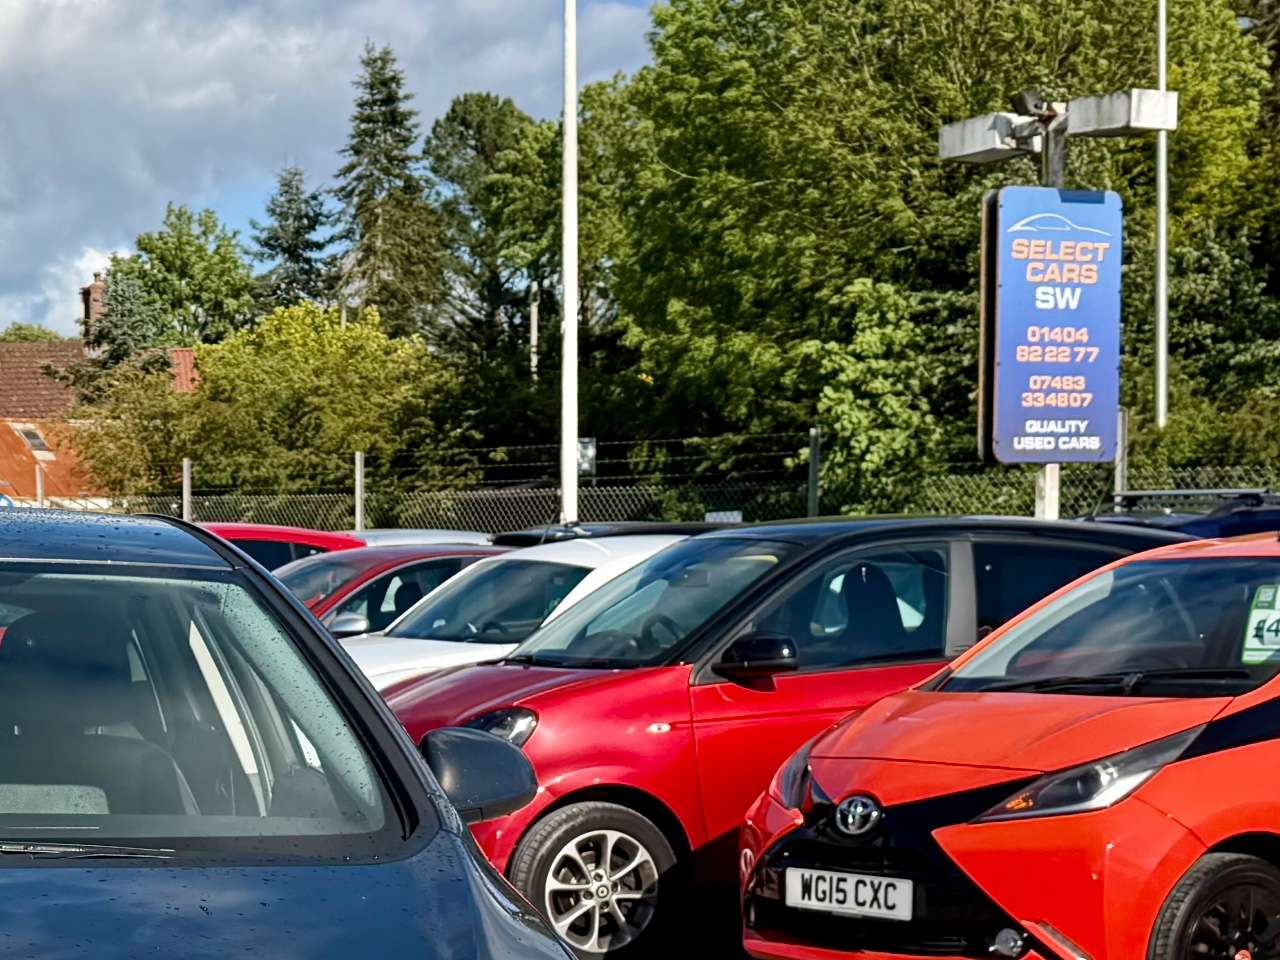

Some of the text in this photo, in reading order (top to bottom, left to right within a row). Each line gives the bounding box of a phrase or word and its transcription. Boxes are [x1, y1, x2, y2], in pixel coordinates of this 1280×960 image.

[1011, 239, 1110, 261] SELECT
[1026, 262, 1098, 284] CARS
[1035, 286, 1081, 310] SW
[1027, 326, 1088, 342] 01404
[1029, 375, 1086, 390] 07483
[1025, 420, 1088, 433] QUALITY
[1013, 437, 1100, 450] USED CARS
[801, 873, 897, 910] WG15 CXC
